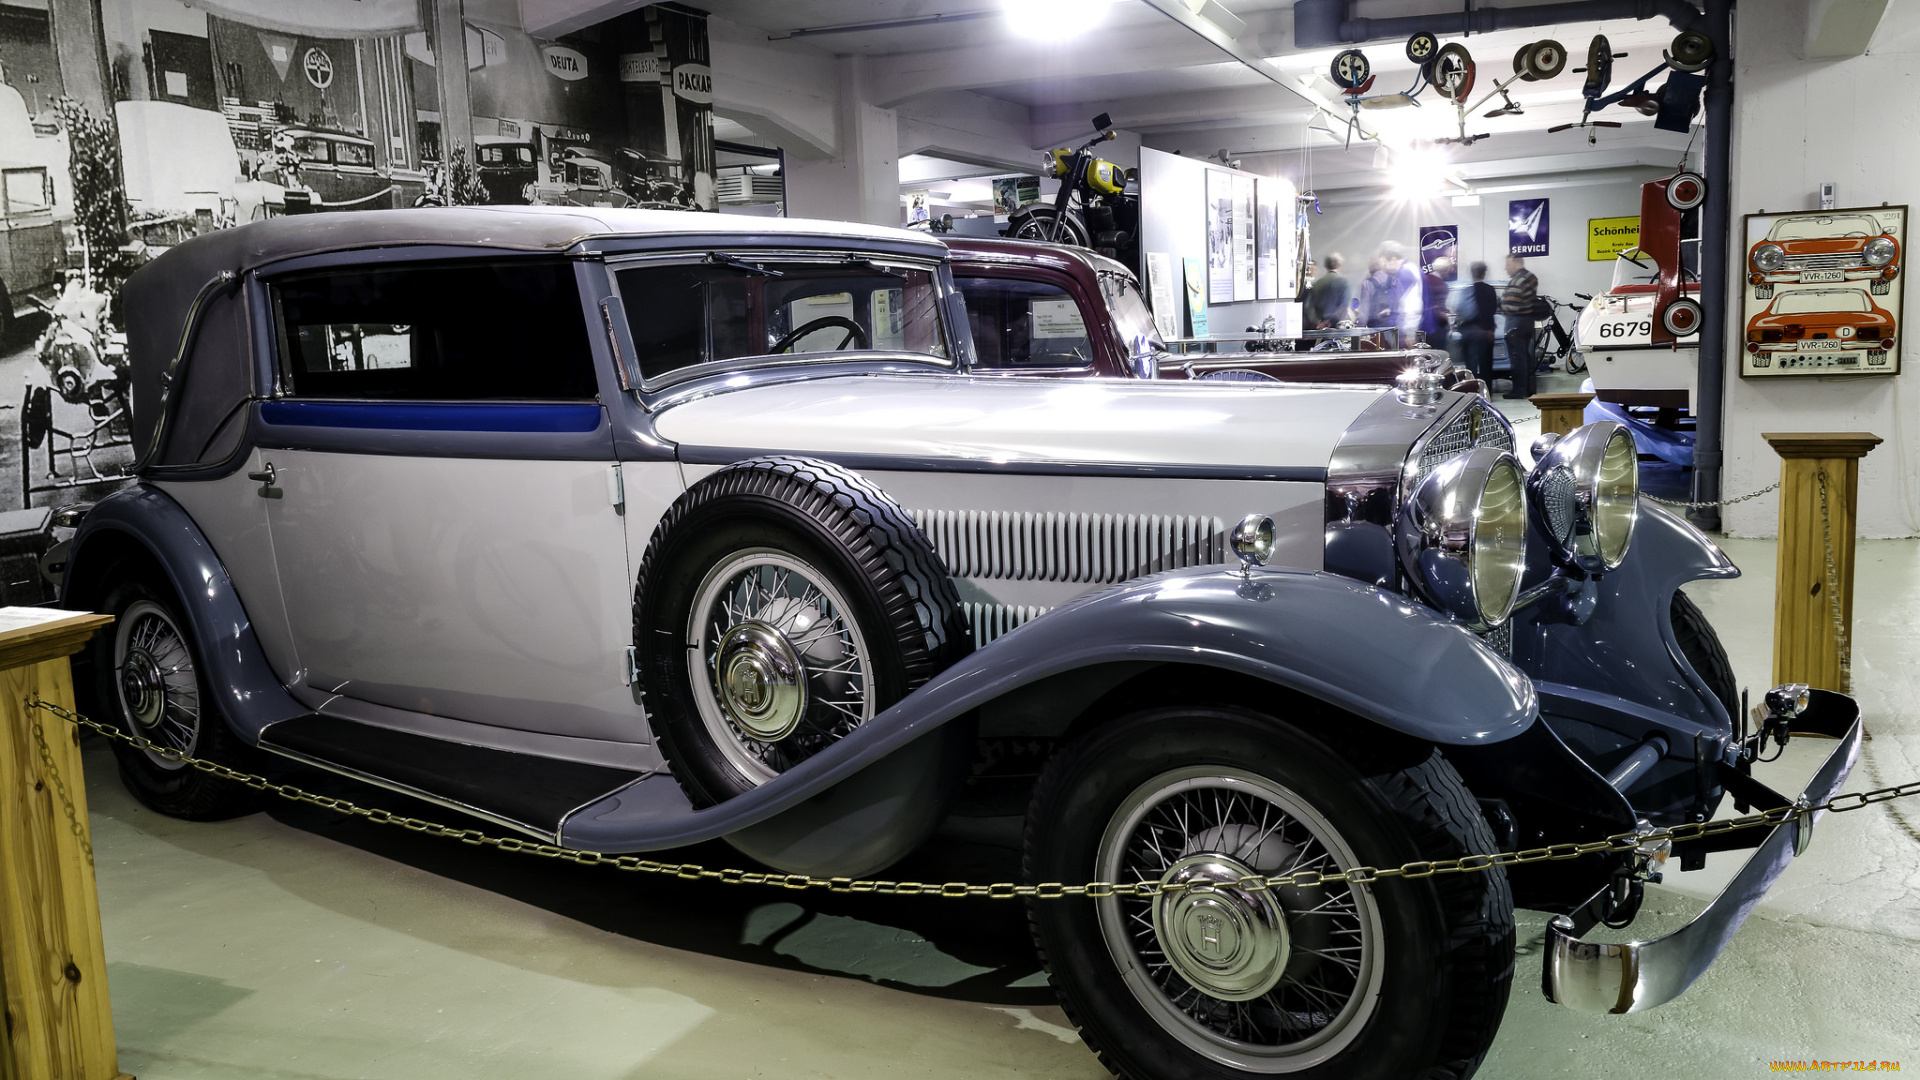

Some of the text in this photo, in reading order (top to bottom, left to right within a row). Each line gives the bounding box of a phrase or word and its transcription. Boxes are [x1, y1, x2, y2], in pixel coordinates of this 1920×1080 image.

[550, 54, 579, 72] DEUTA
[1511, 244, 1546, 254] SERVICE
[1803, 272, 1841, 280] VVR-1260
[1600, 321, 1651, 338] 6679
[1842, 327, 1850, 337] D
[1801, 341, 1839, 349] VVR-1260
